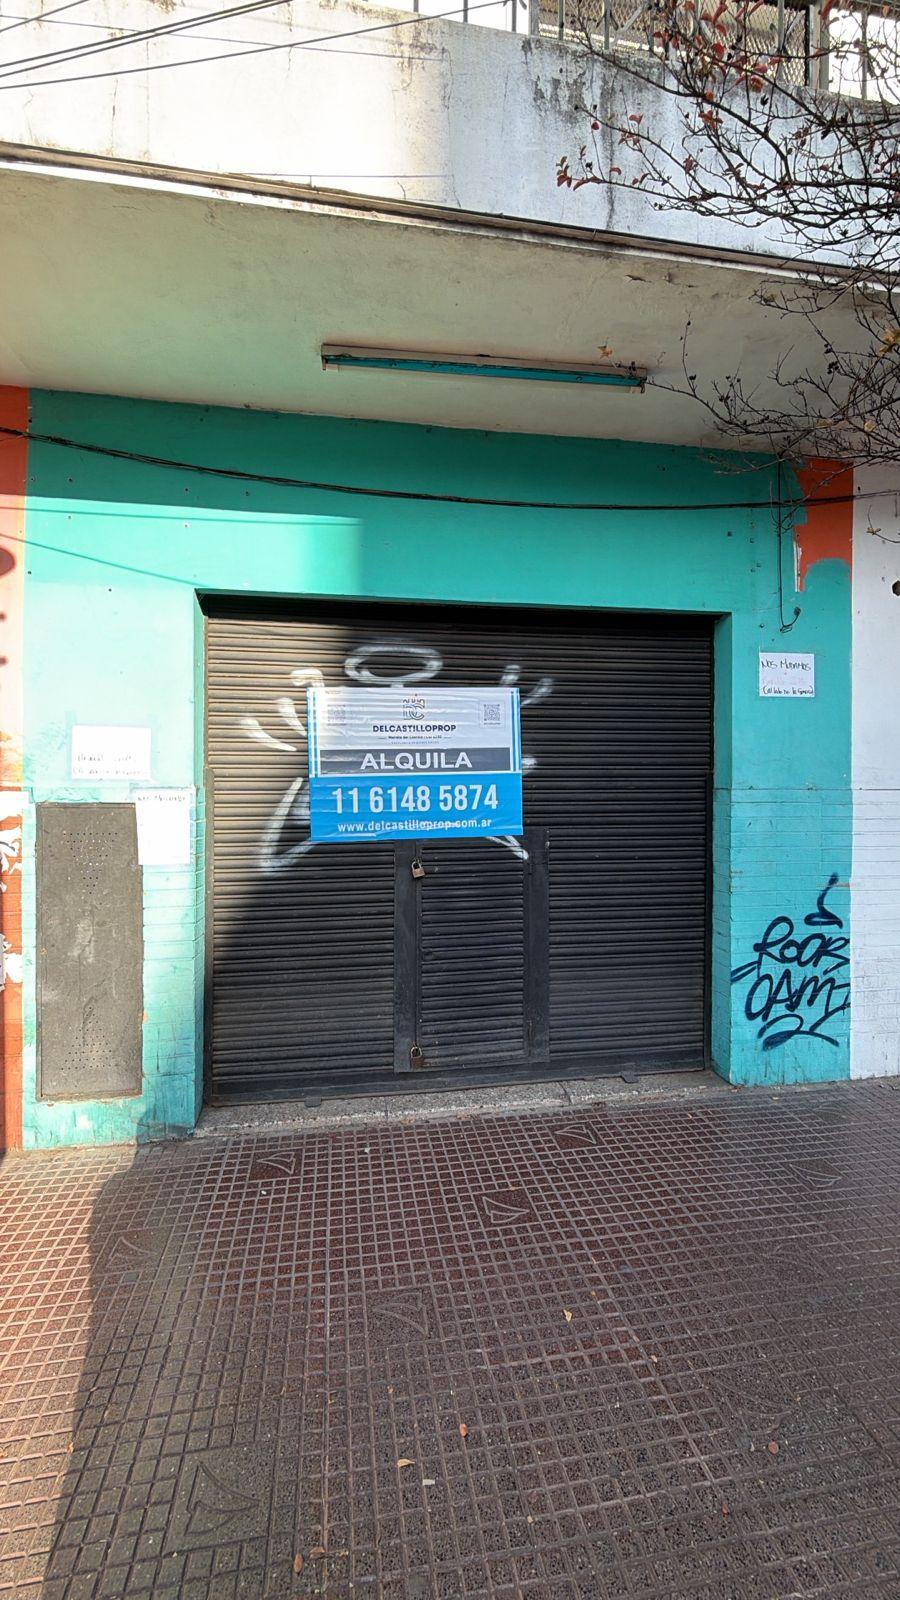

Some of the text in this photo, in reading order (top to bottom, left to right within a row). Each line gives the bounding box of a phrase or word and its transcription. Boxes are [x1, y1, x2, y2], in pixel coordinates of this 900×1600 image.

[372, 724, 457, 733] DELCASTILLOPROP
[360, 751, 473, 770] ALQUILA
[332, 784, 499, 814] 11 6148 5874
[337, 818, 492, 833] www.delcastilloprop.com.ar
